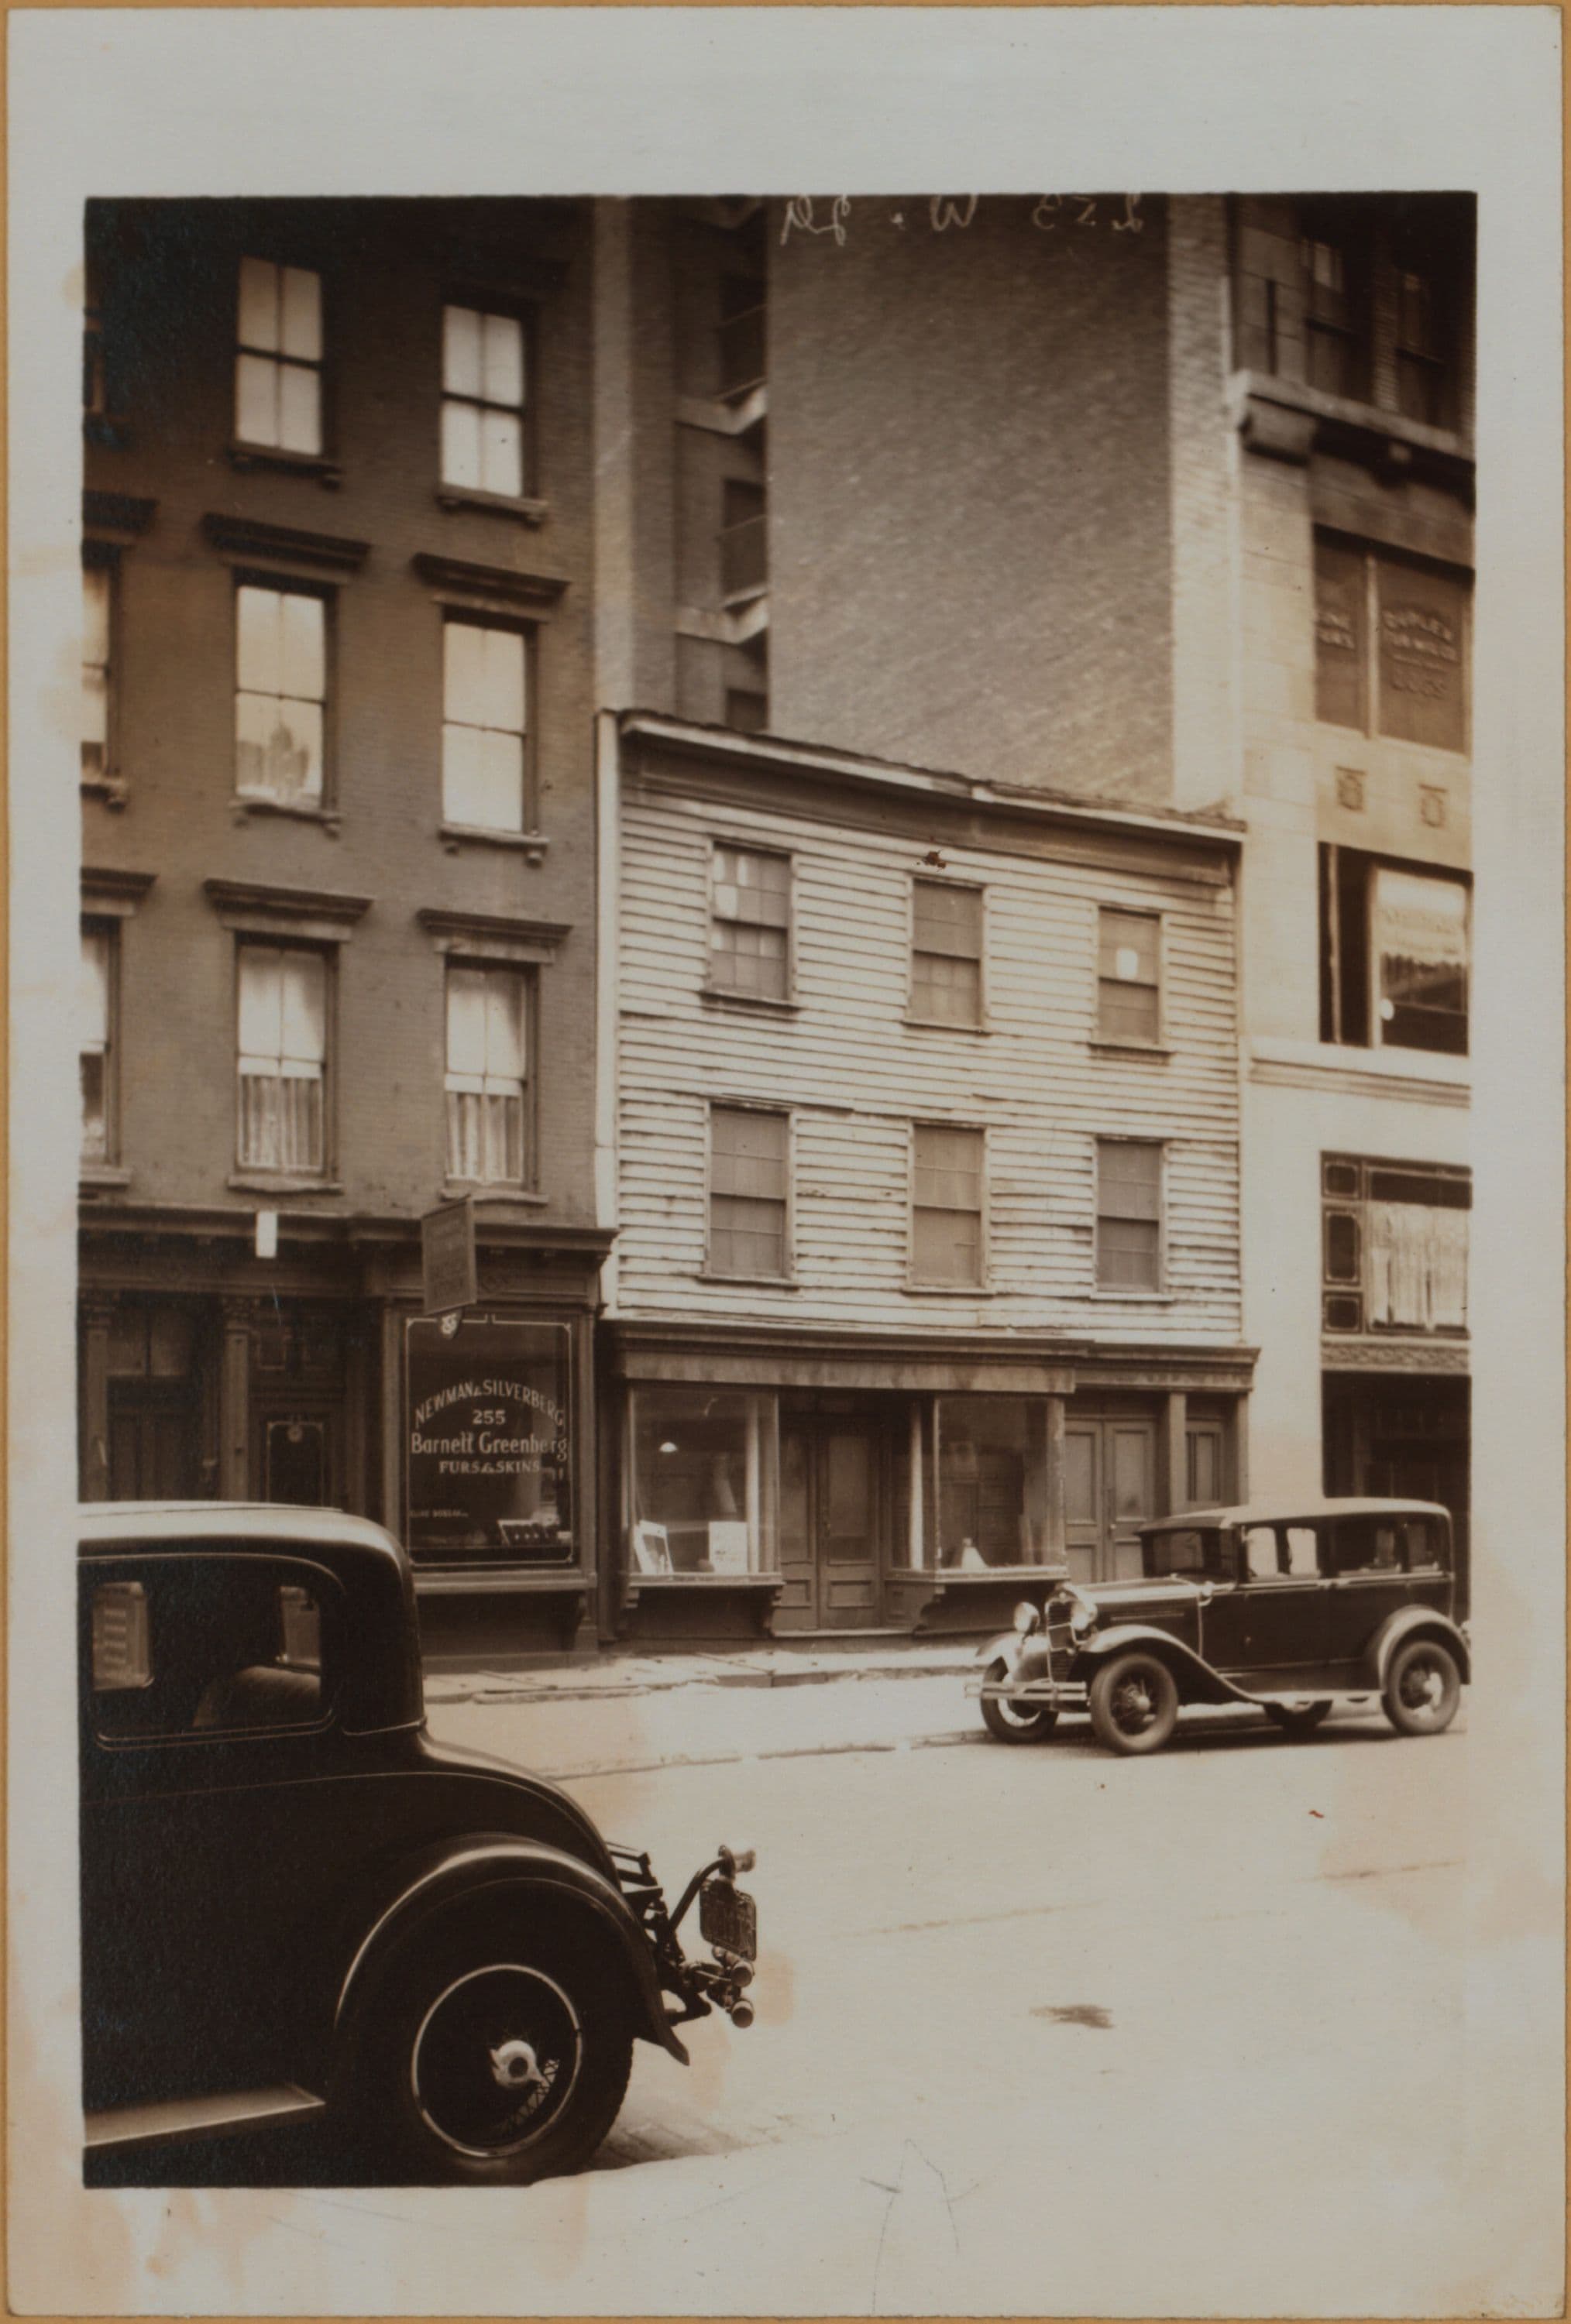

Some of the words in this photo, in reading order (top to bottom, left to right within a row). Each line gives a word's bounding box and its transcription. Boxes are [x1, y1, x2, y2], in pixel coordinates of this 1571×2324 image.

[415, 1382, 473, 1428] NEWMAN
[483, 1379, 565, 1426] SILVERBERG
[473, 1409, 506, 1425] 255
[411, 1432, 473, 1454] Barnett
[479, 1432, 567, 1462] Greenberg
[439, 1461, 480, 1474] FURS
[496, 1461, 541, 1473] SKINS
